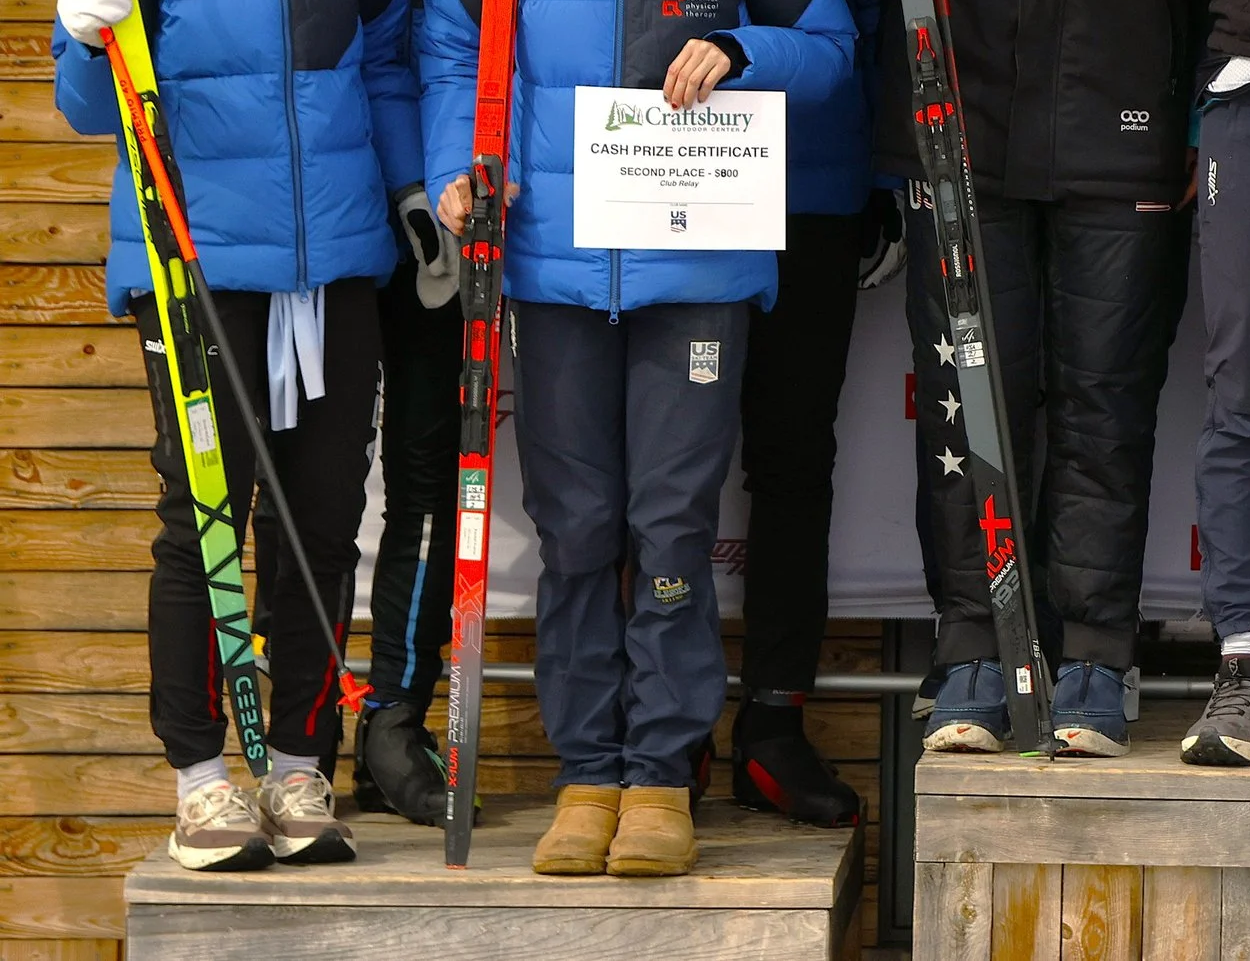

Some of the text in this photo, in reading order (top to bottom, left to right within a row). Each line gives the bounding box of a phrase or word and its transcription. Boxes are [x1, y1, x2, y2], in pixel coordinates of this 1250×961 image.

[685, 2, 719, 11] physical
[685, 10, 717, 19] therapy
[645, 106, 754, 133] Craftsbury
[1120, 123, 1149, 132] podium
[590, 142, 770, 158] CASH PRIZE CERTIFICATE
[619, 166, 666, 178] SECOND
[668, 168, 705, 178] PLACE
[660, 180, 700, 189] Club Relay
[670, 210, 687, 219] US
[692, 342, 718, 355] US
